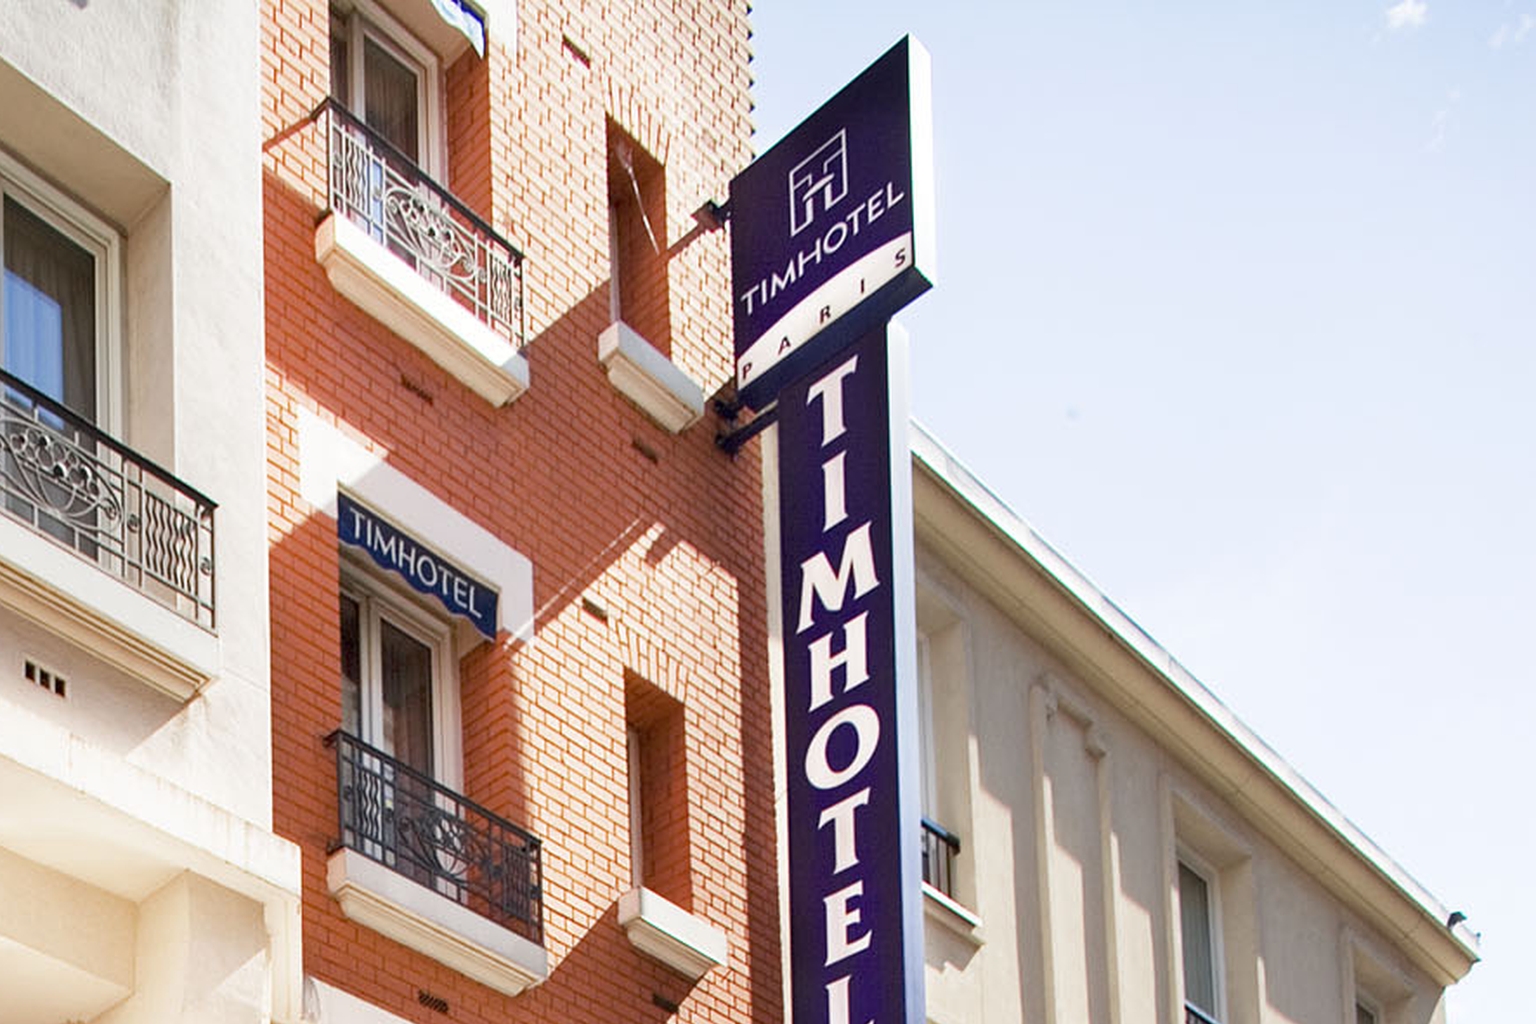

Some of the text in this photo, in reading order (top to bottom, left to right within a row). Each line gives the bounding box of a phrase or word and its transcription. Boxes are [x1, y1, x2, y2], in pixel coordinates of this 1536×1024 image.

[741, 182, 904, 315] TIMHOTEL
[742, 248, 906, 380] PARIS
[350, 507, 482, 619] TIMHOTEL
